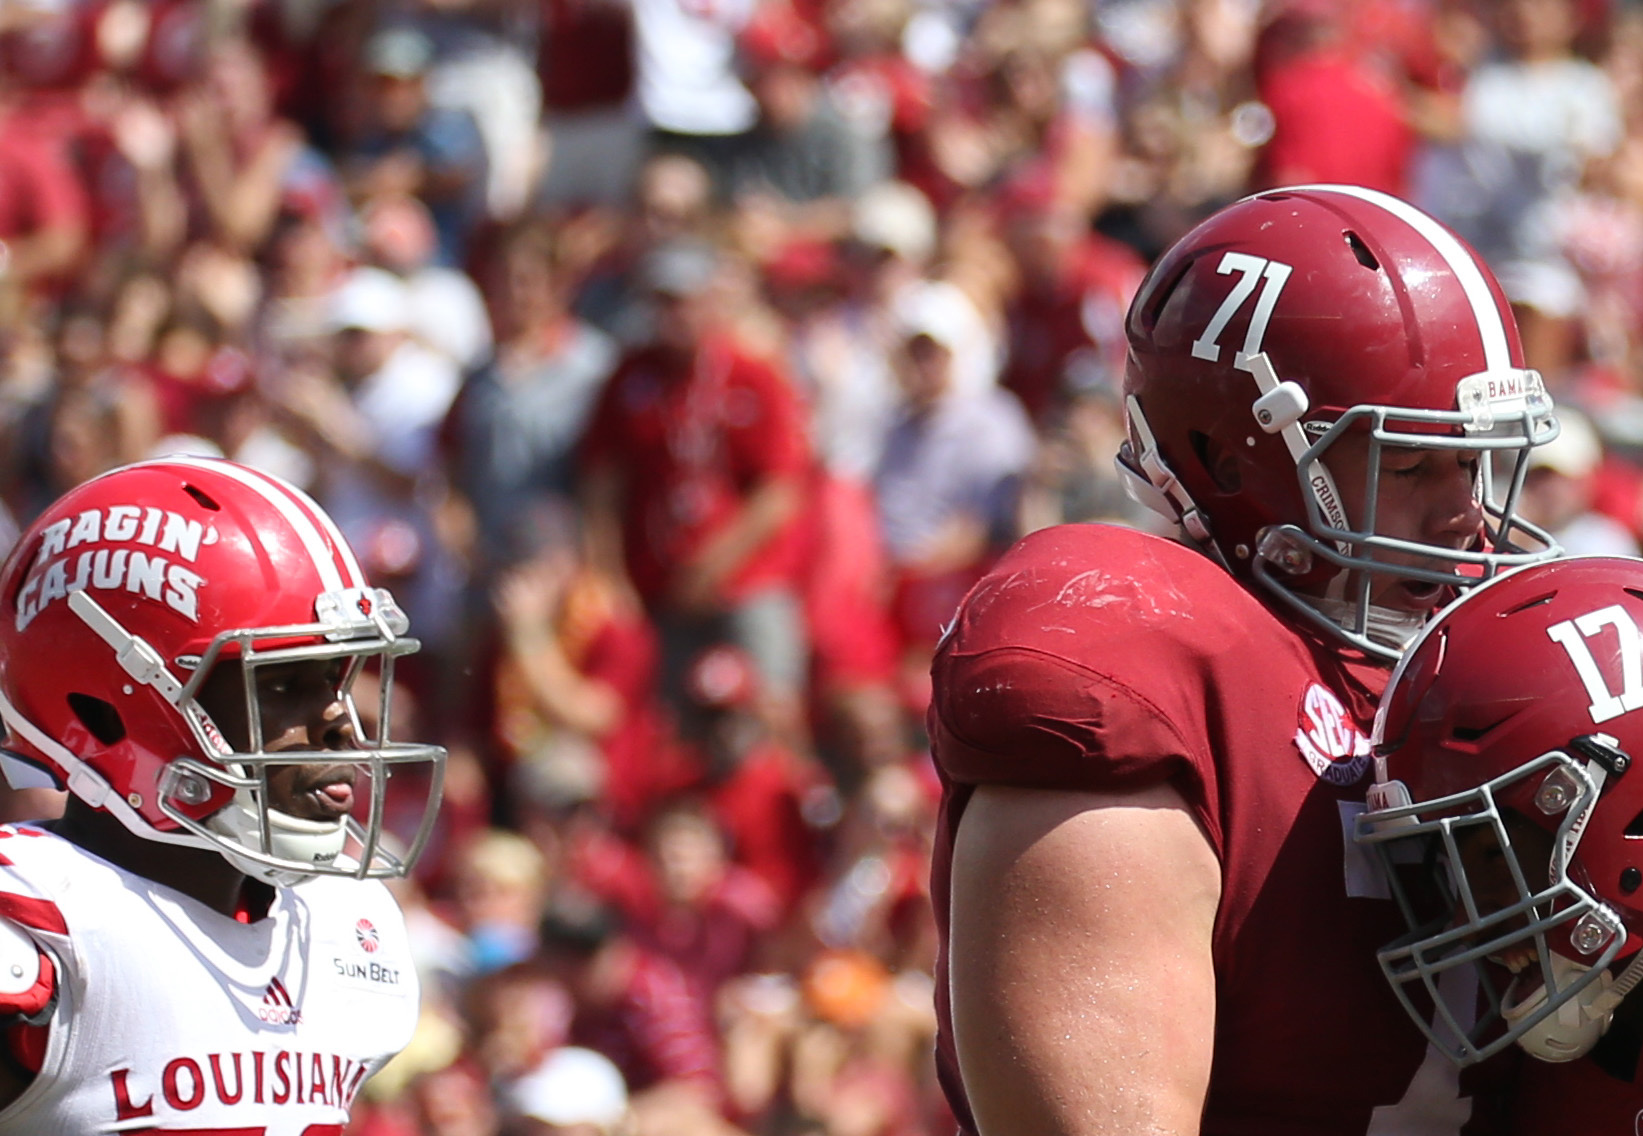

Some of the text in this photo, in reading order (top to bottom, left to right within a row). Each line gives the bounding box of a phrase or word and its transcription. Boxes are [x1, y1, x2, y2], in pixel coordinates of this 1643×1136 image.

[1191, 251, 1293, 371] 71
[38, 504, 219, 563] RAGIN'
[1311, 475, 1346, 533] CRIMSO
[15, 548, 207, 632] CAJUNS
[258, 1007, 304, 1025] adidas
